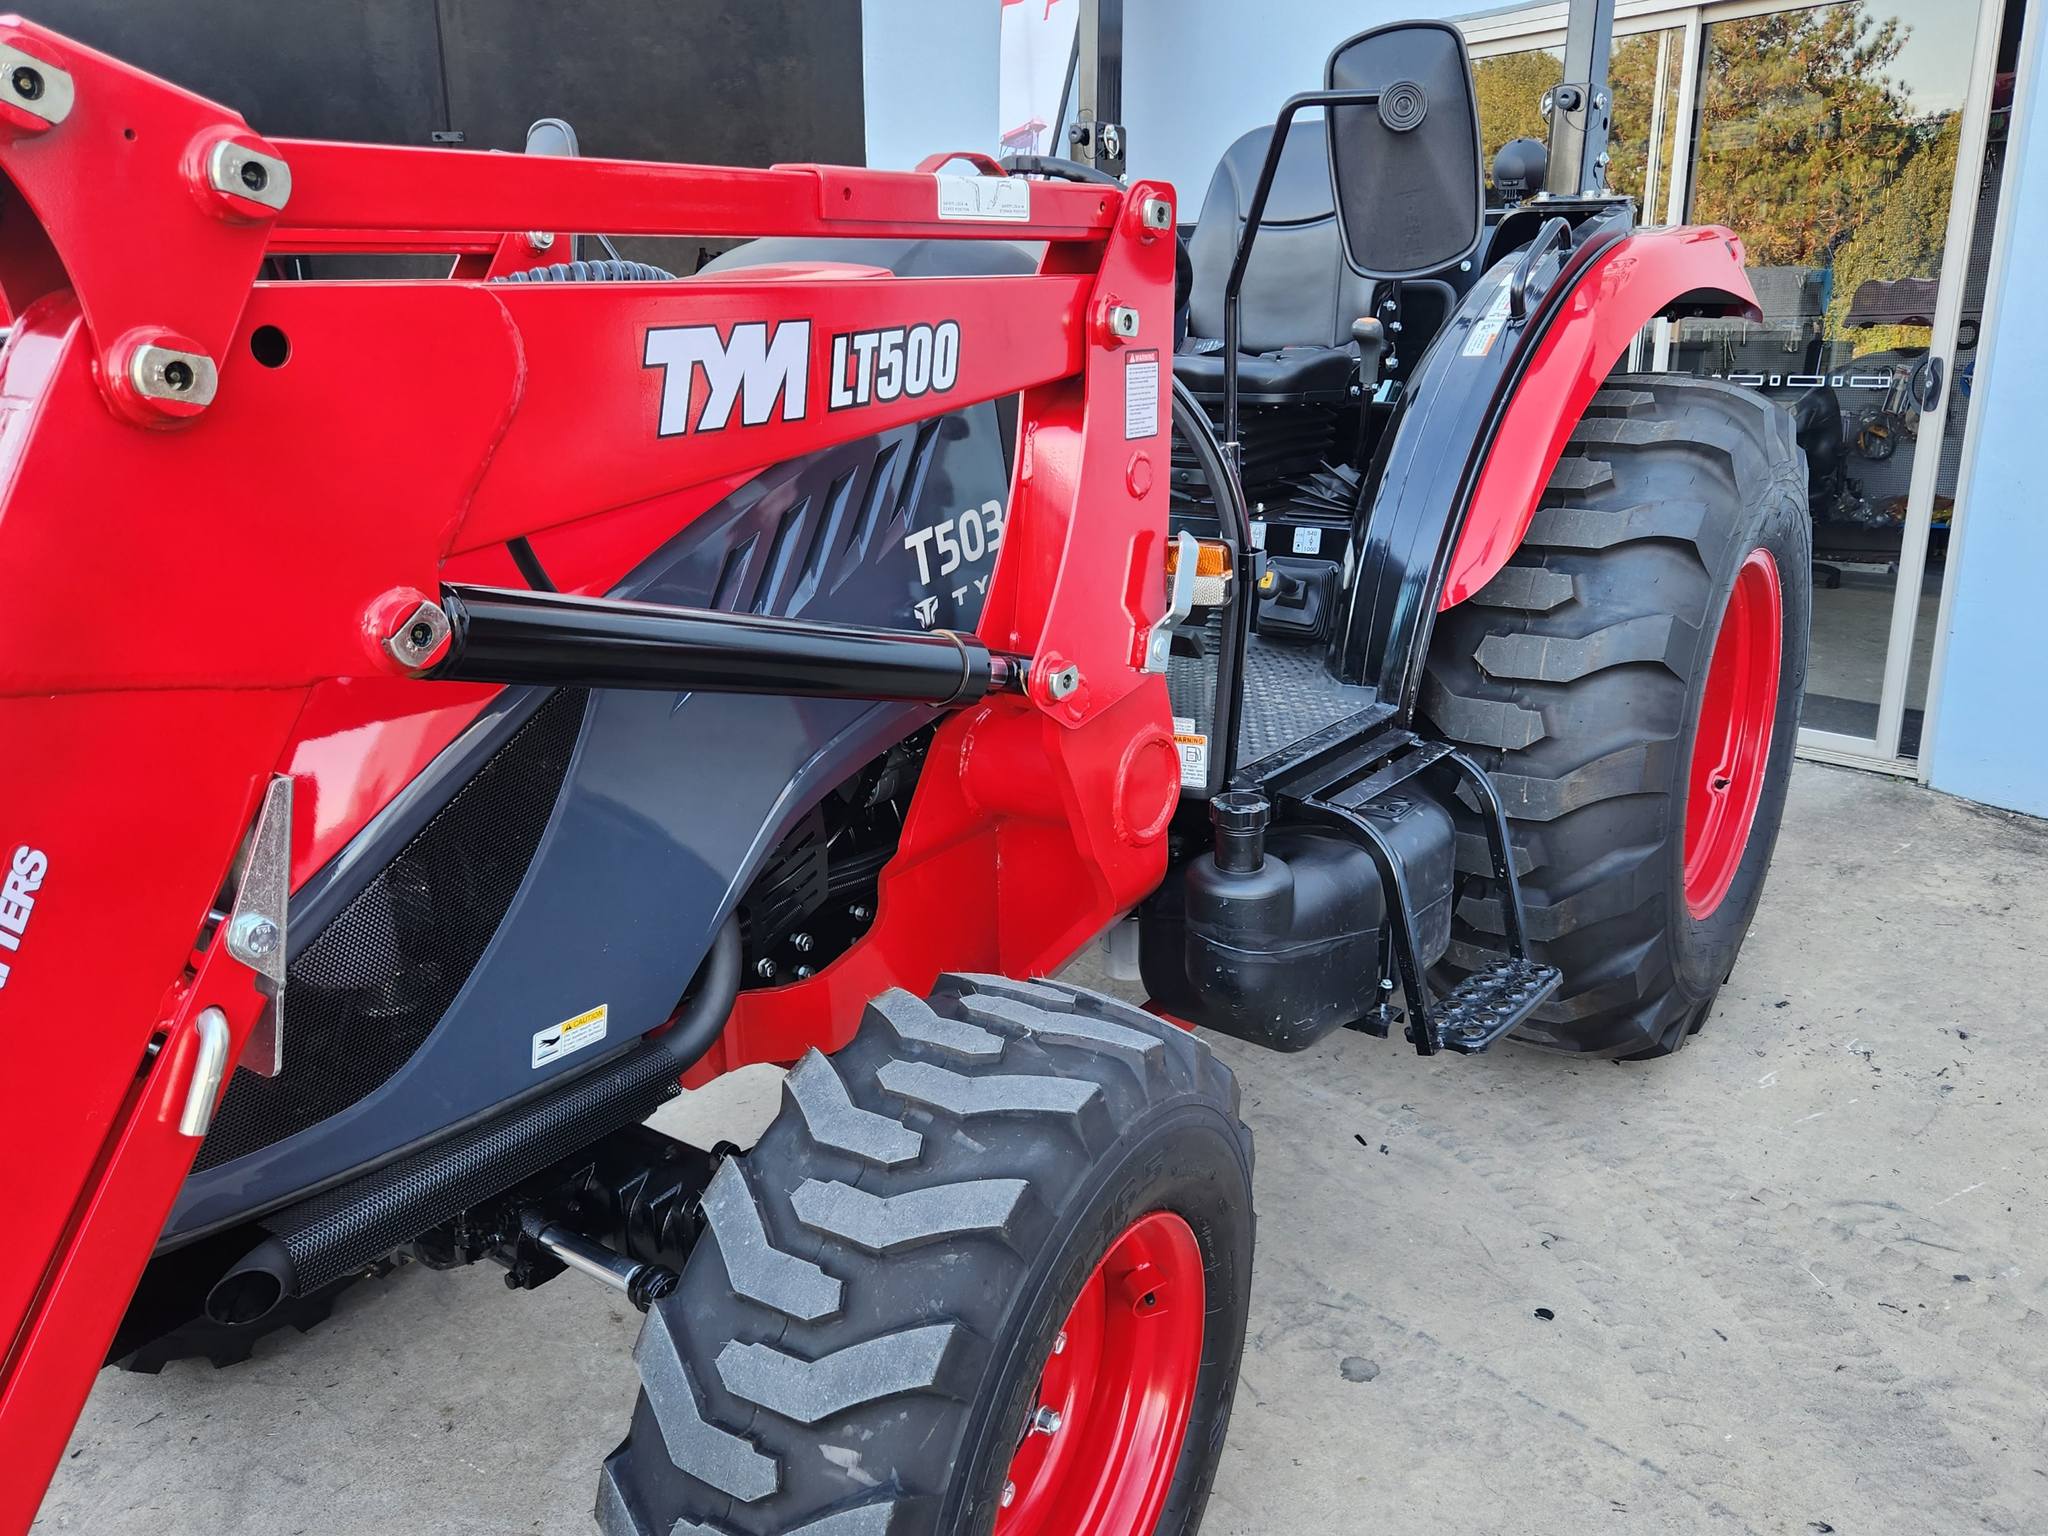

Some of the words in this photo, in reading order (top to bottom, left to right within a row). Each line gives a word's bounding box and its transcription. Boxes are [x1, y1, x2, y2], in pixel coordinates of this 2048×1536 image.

[643, 319, 811, 439] TYM
[828, 319, 960, 412] LT500
[904, 499, 1005, 586] T503
[0, 845, 48, 989] IERS
[573, 1008, 604, 1028] CAUTION
